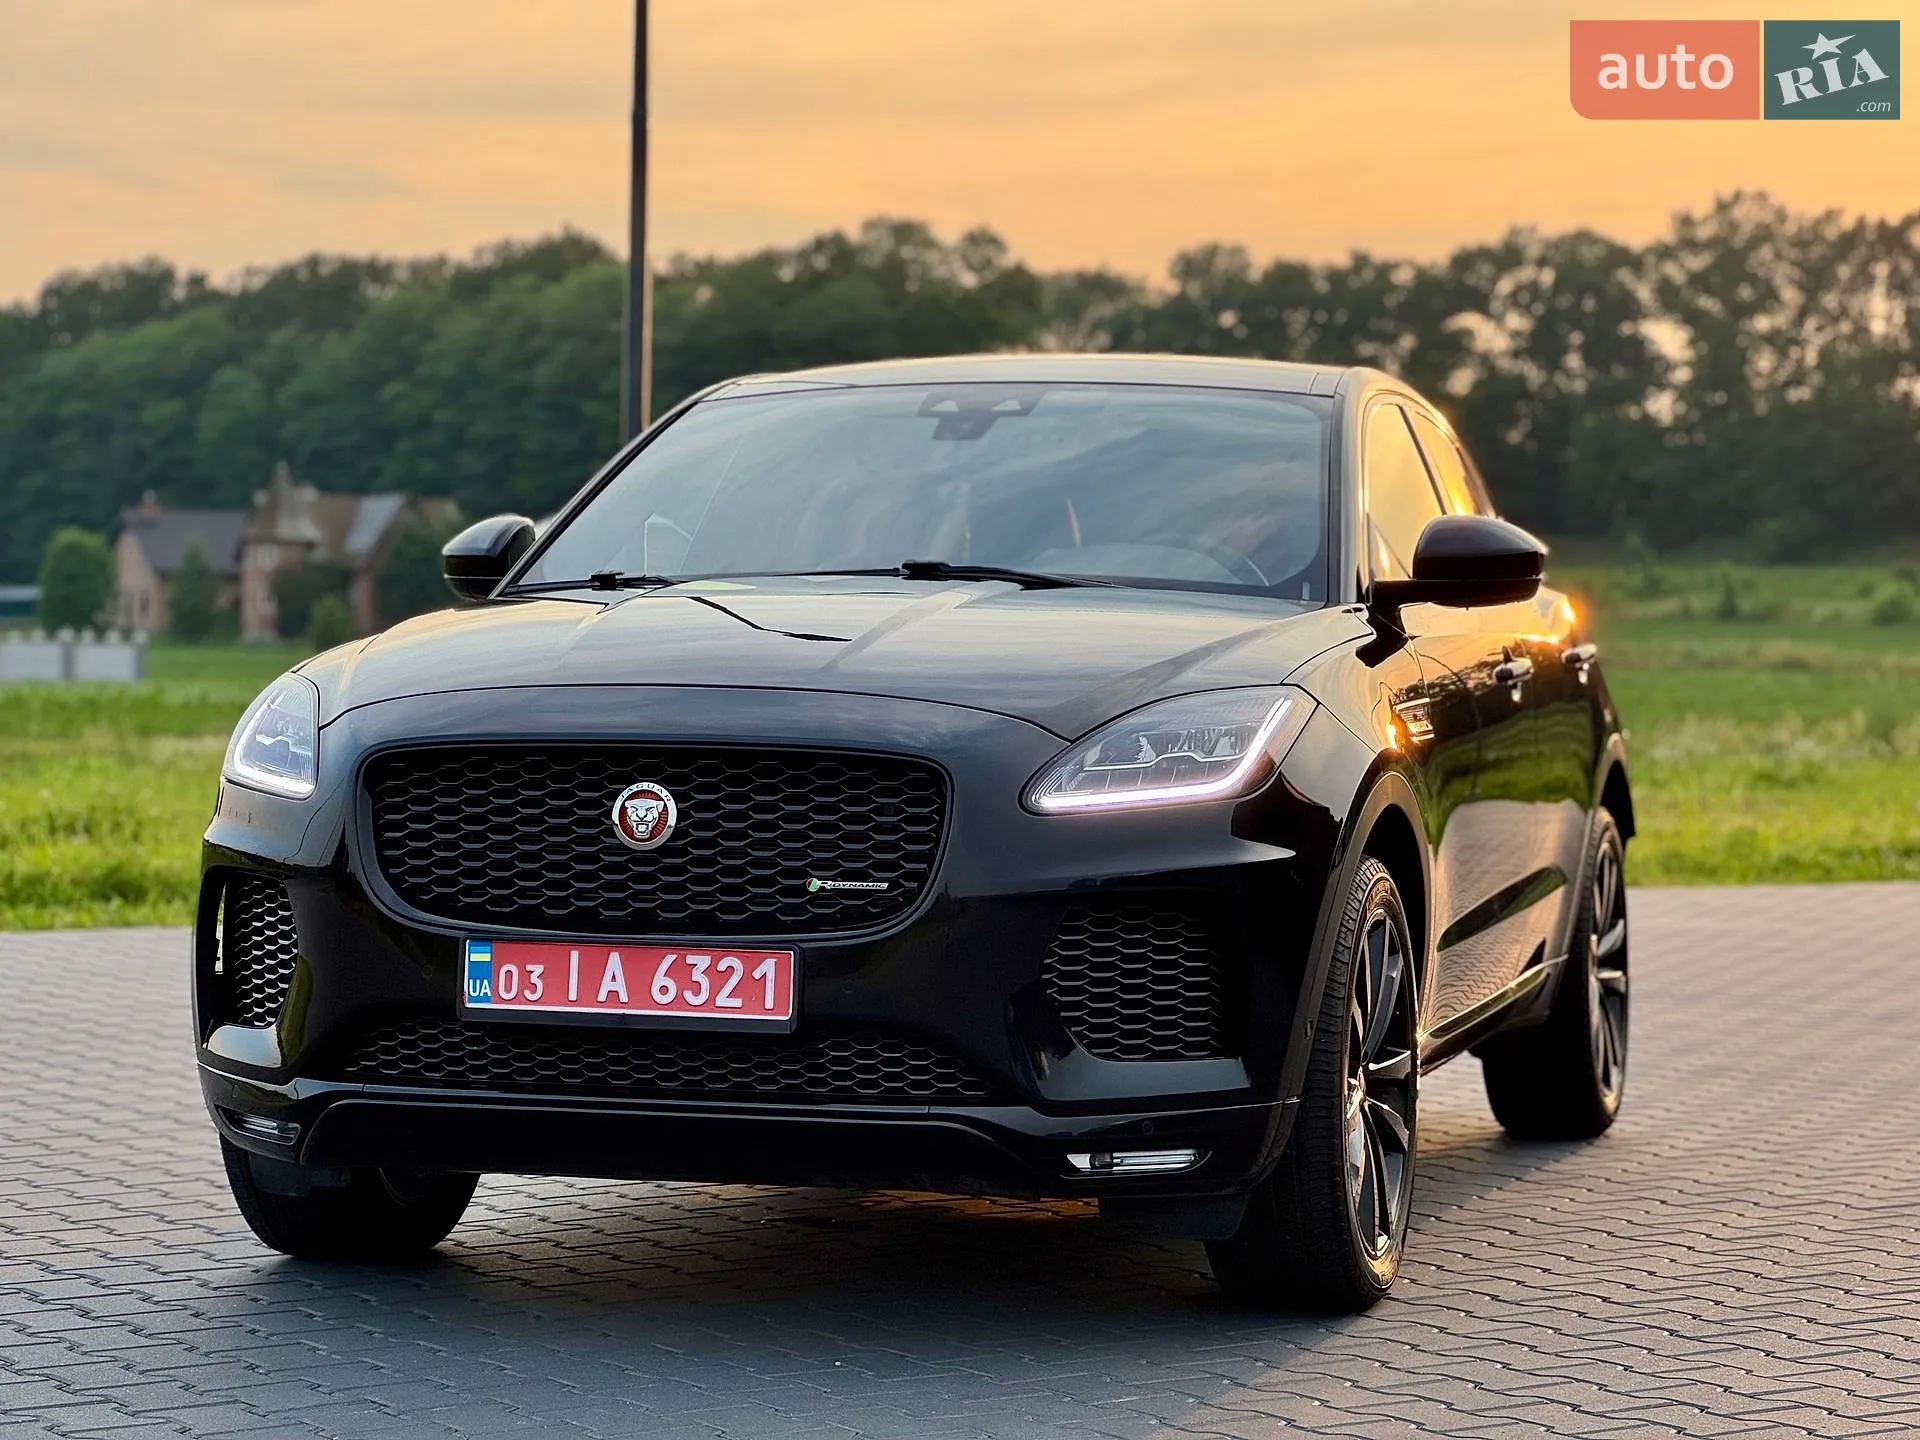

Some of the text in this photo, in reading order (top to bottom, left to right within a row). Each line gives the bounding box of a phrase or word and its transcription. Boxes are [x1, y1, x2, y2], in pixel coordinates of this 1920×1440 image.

[619, 783, 672, 803] JAGUAR
[468, 978, 492, 998] UA
[498, 963, 545, 1002] 03
[650, 953, 778, 1011] 6321
